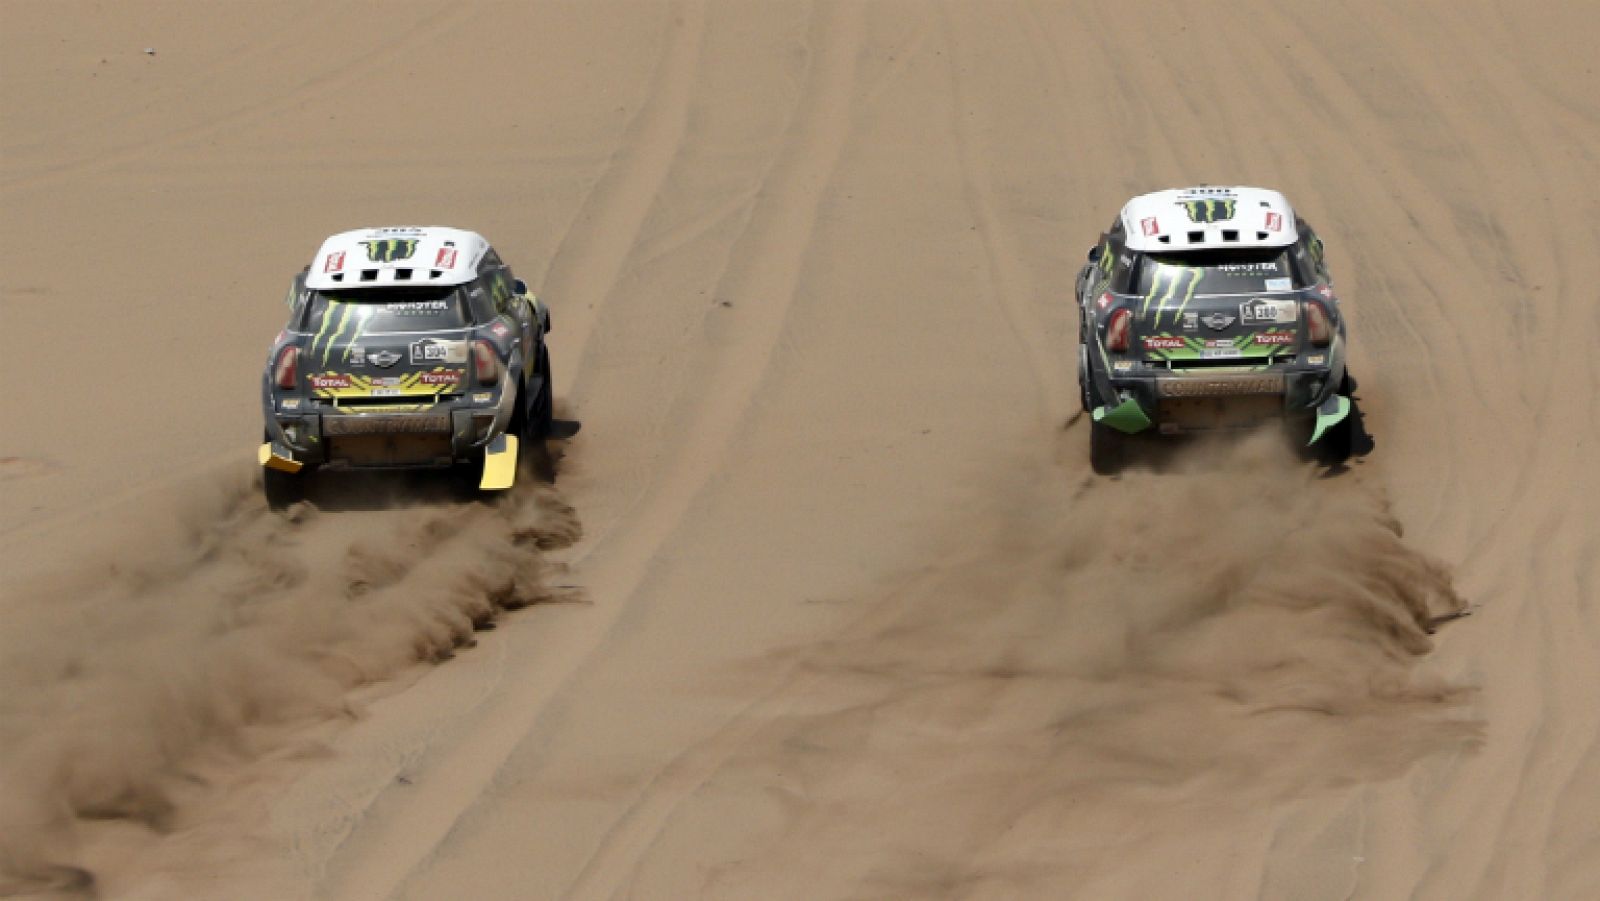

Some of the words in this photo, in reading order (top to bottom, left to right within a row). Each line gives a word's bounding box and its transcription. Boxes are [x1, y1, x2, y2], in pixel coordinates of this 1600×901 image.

[1145, 339, 1182, 348] TOTAL
[1256, 335, 1292, 344] TOTAL
[312, 378, 349, 387] TOTAL
[422, 373, 459, 383] TOTAL
